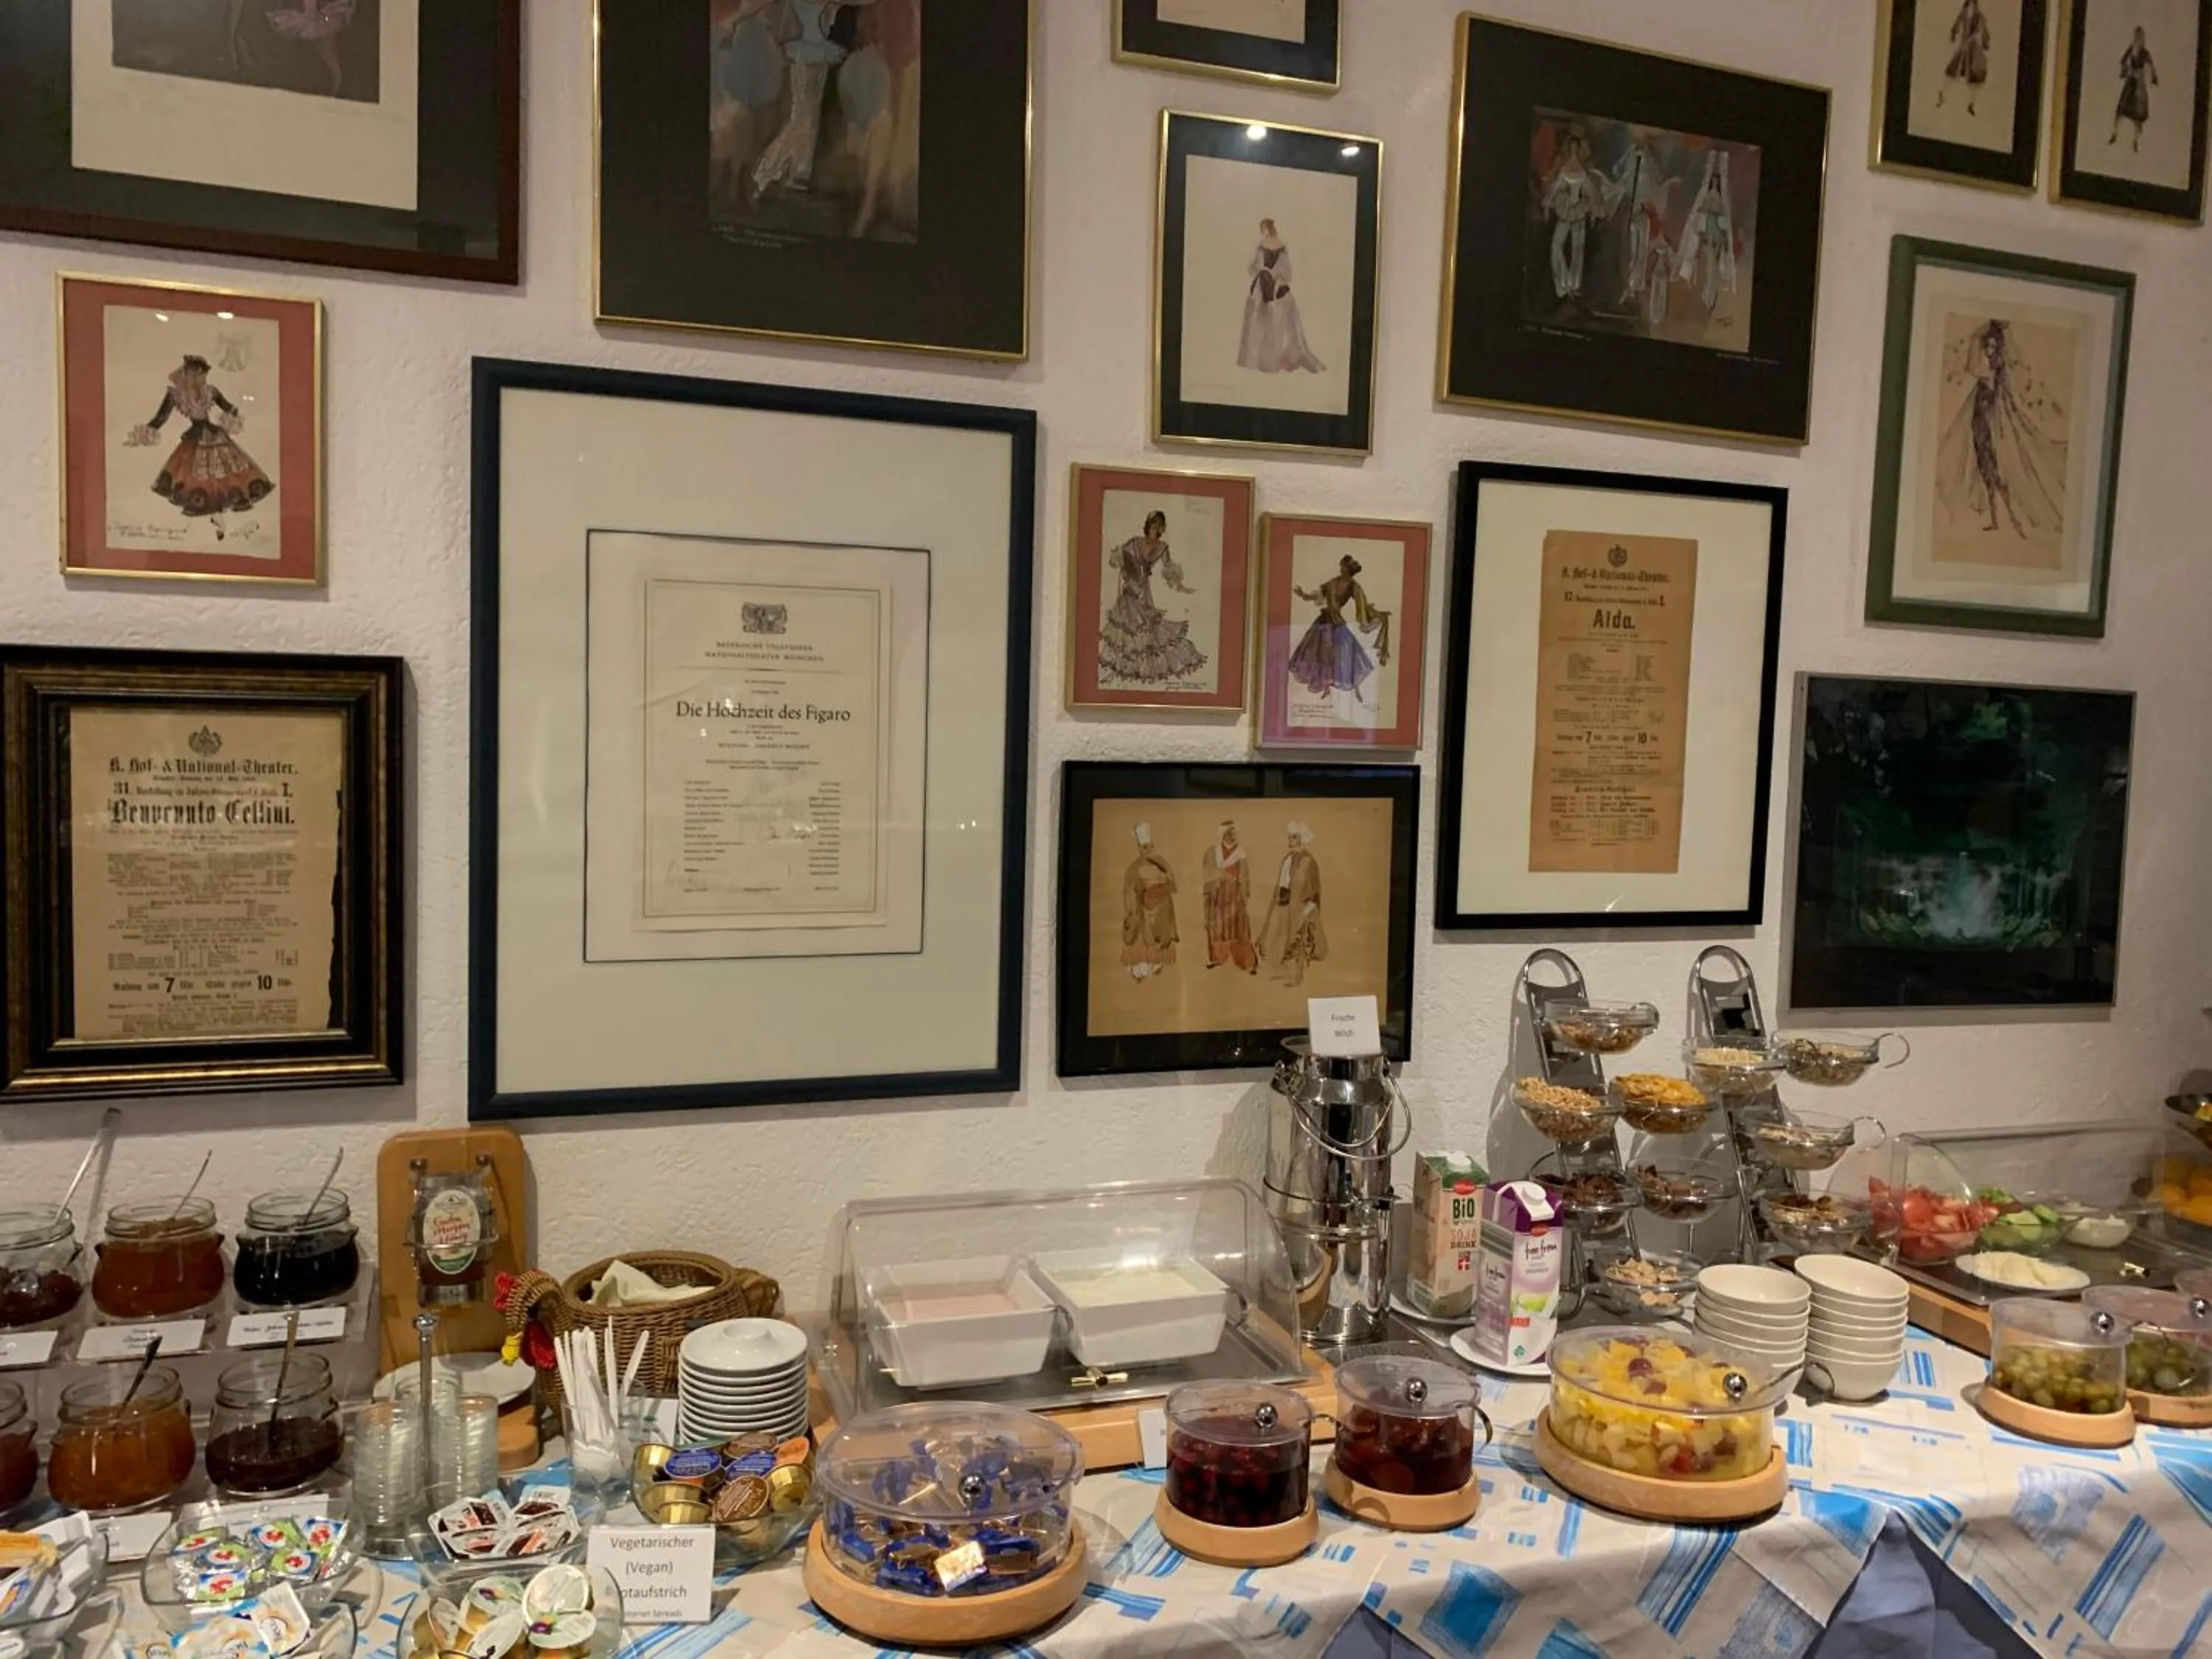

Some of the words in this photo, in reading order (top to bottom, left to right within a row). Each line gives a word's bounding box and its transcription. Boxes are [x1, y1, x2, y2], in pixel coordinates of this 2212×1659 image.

[676, 700, 703, 717] Die
[707, 702, 774, 720] Hochzeit
[778, 704, 802, 720] des
[806, 705, 851, 724] Figaro
[1586, 731, 1592, 744] 7
[1638, 731, 1648, 744] 10
[165, 977, 175, 993] 7
[257, 975, 273, 991] 10
[611, 1537, 695, 1551] Vegetarischer
[626, 1561, 673, 1576] (Vegan)
[620, 1585, 687, 1599] otaufstrich
